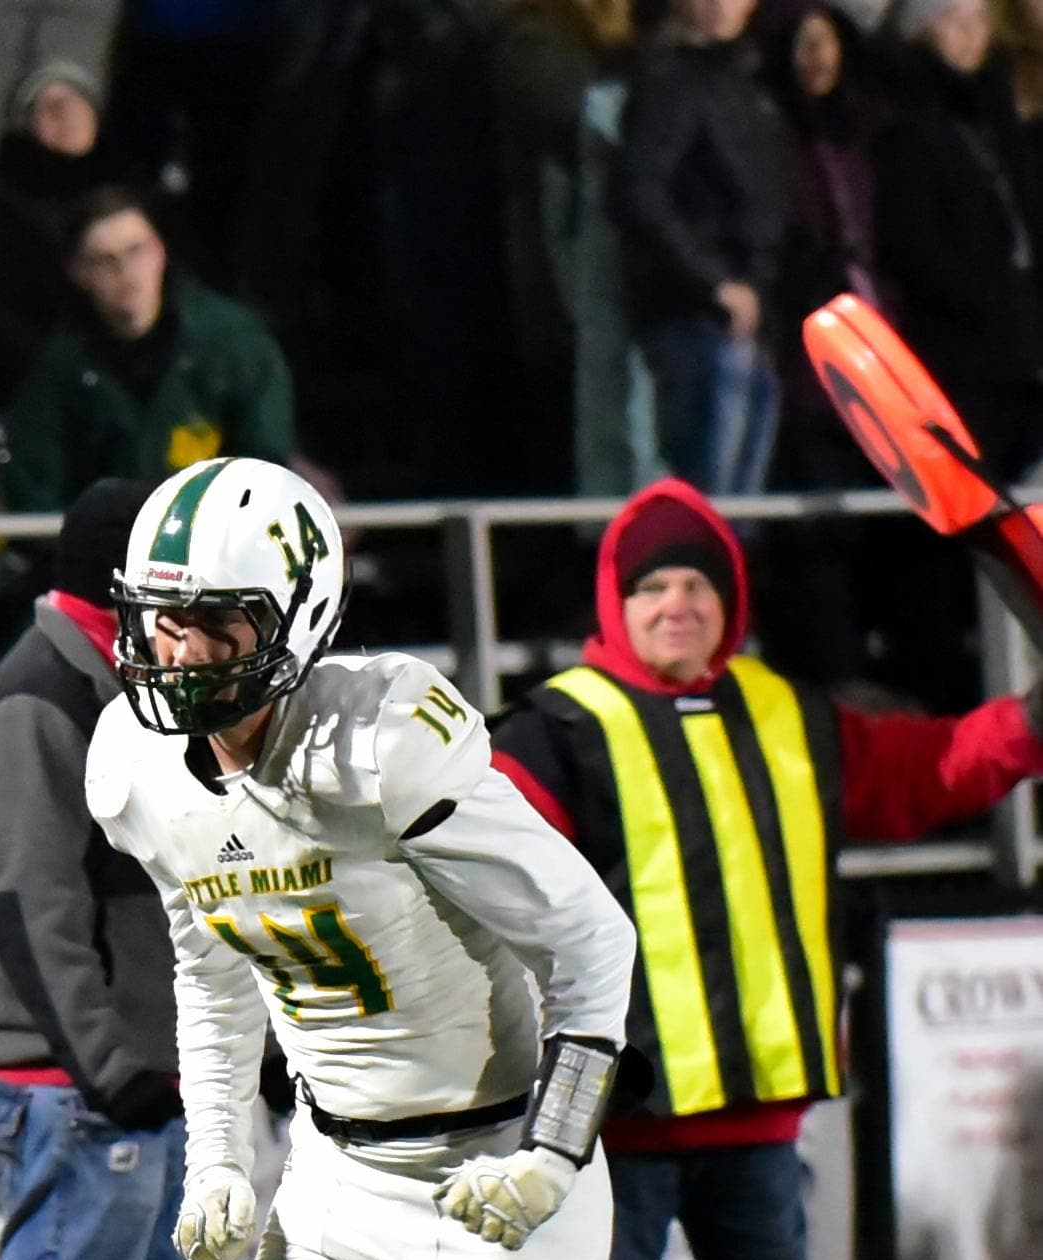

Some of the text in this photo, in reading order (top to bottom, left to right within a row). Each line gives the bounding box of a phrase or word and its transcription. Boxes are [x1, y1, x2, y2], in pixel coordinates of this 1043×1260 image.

[266, 501, 330, 583] 14
[409, 684, 467, 747] 14
[217, 850, 255, 863] adidas
[249, 857, 334, 893] MIAMI
[204, 902, 396, 1021] 14
